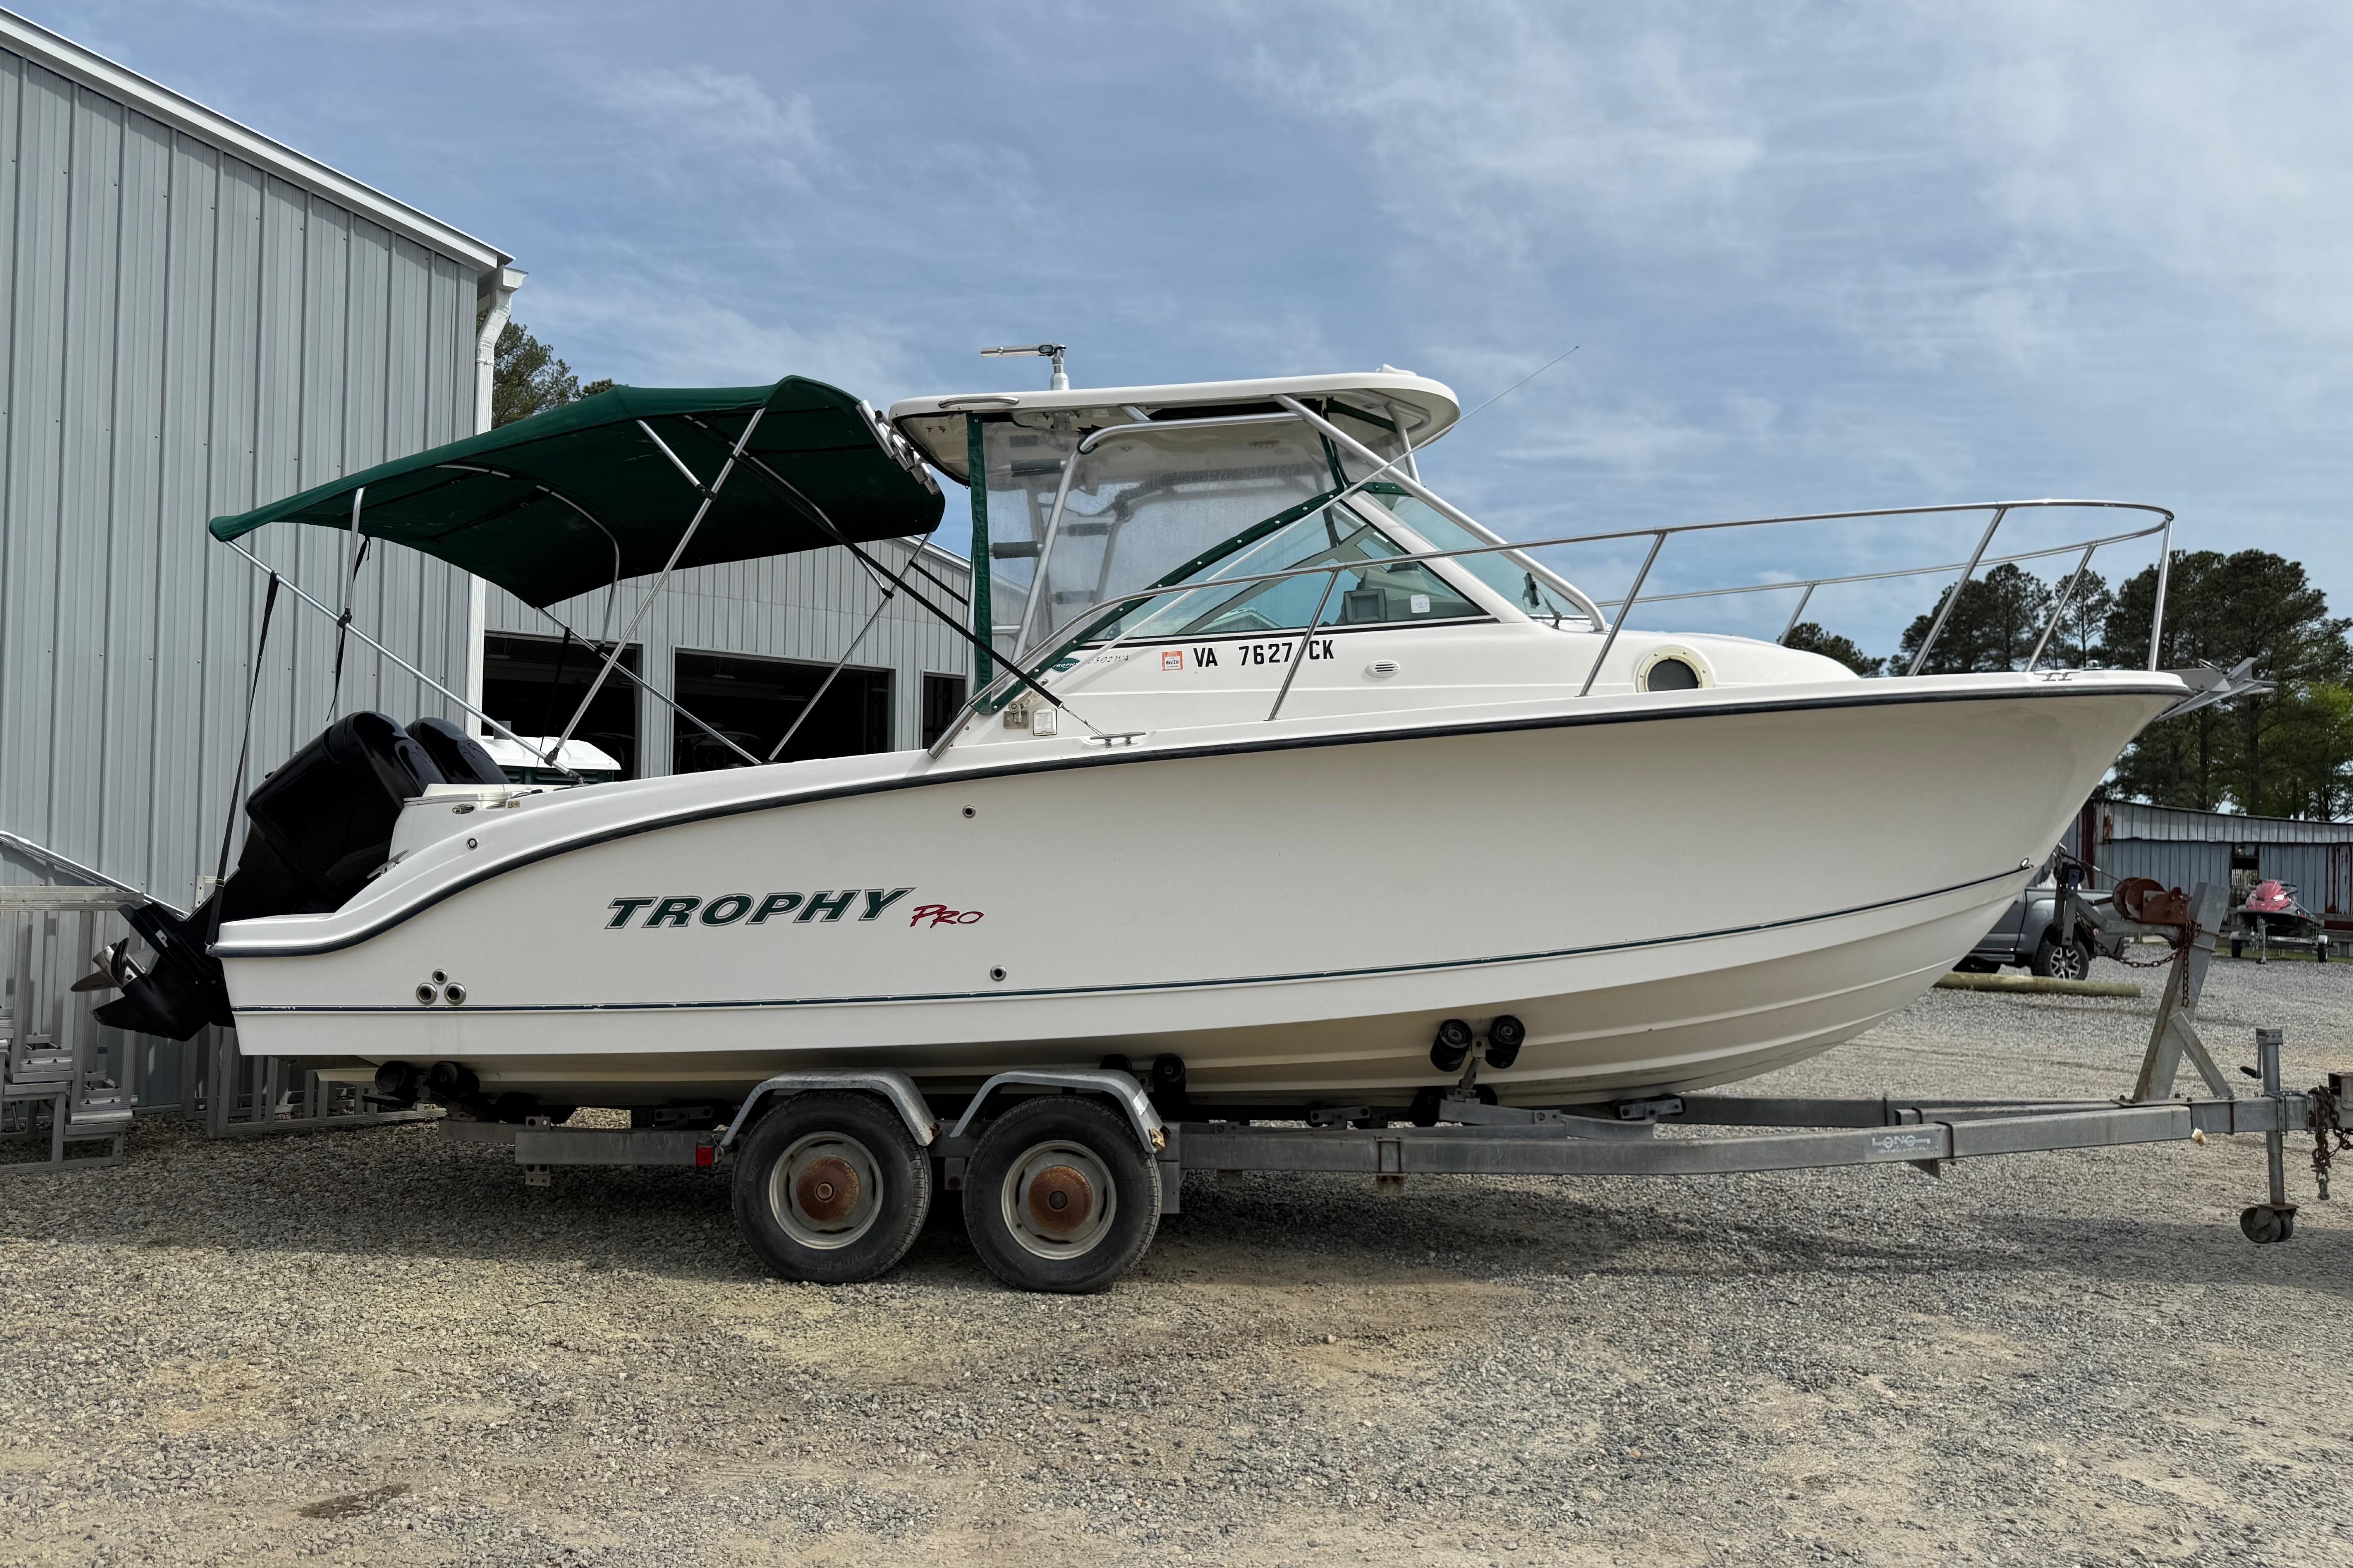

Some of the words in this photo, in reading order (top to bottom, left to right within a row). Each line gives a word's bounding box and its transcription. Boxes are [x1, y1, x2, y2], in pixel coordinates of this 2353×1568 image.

[1193, 647, 1218, 667] VA
[1238, 642, 1292, 666] 7627
[1309, 640, 1334, 660] CK
[605, 887, 917, 930] TROPHY
